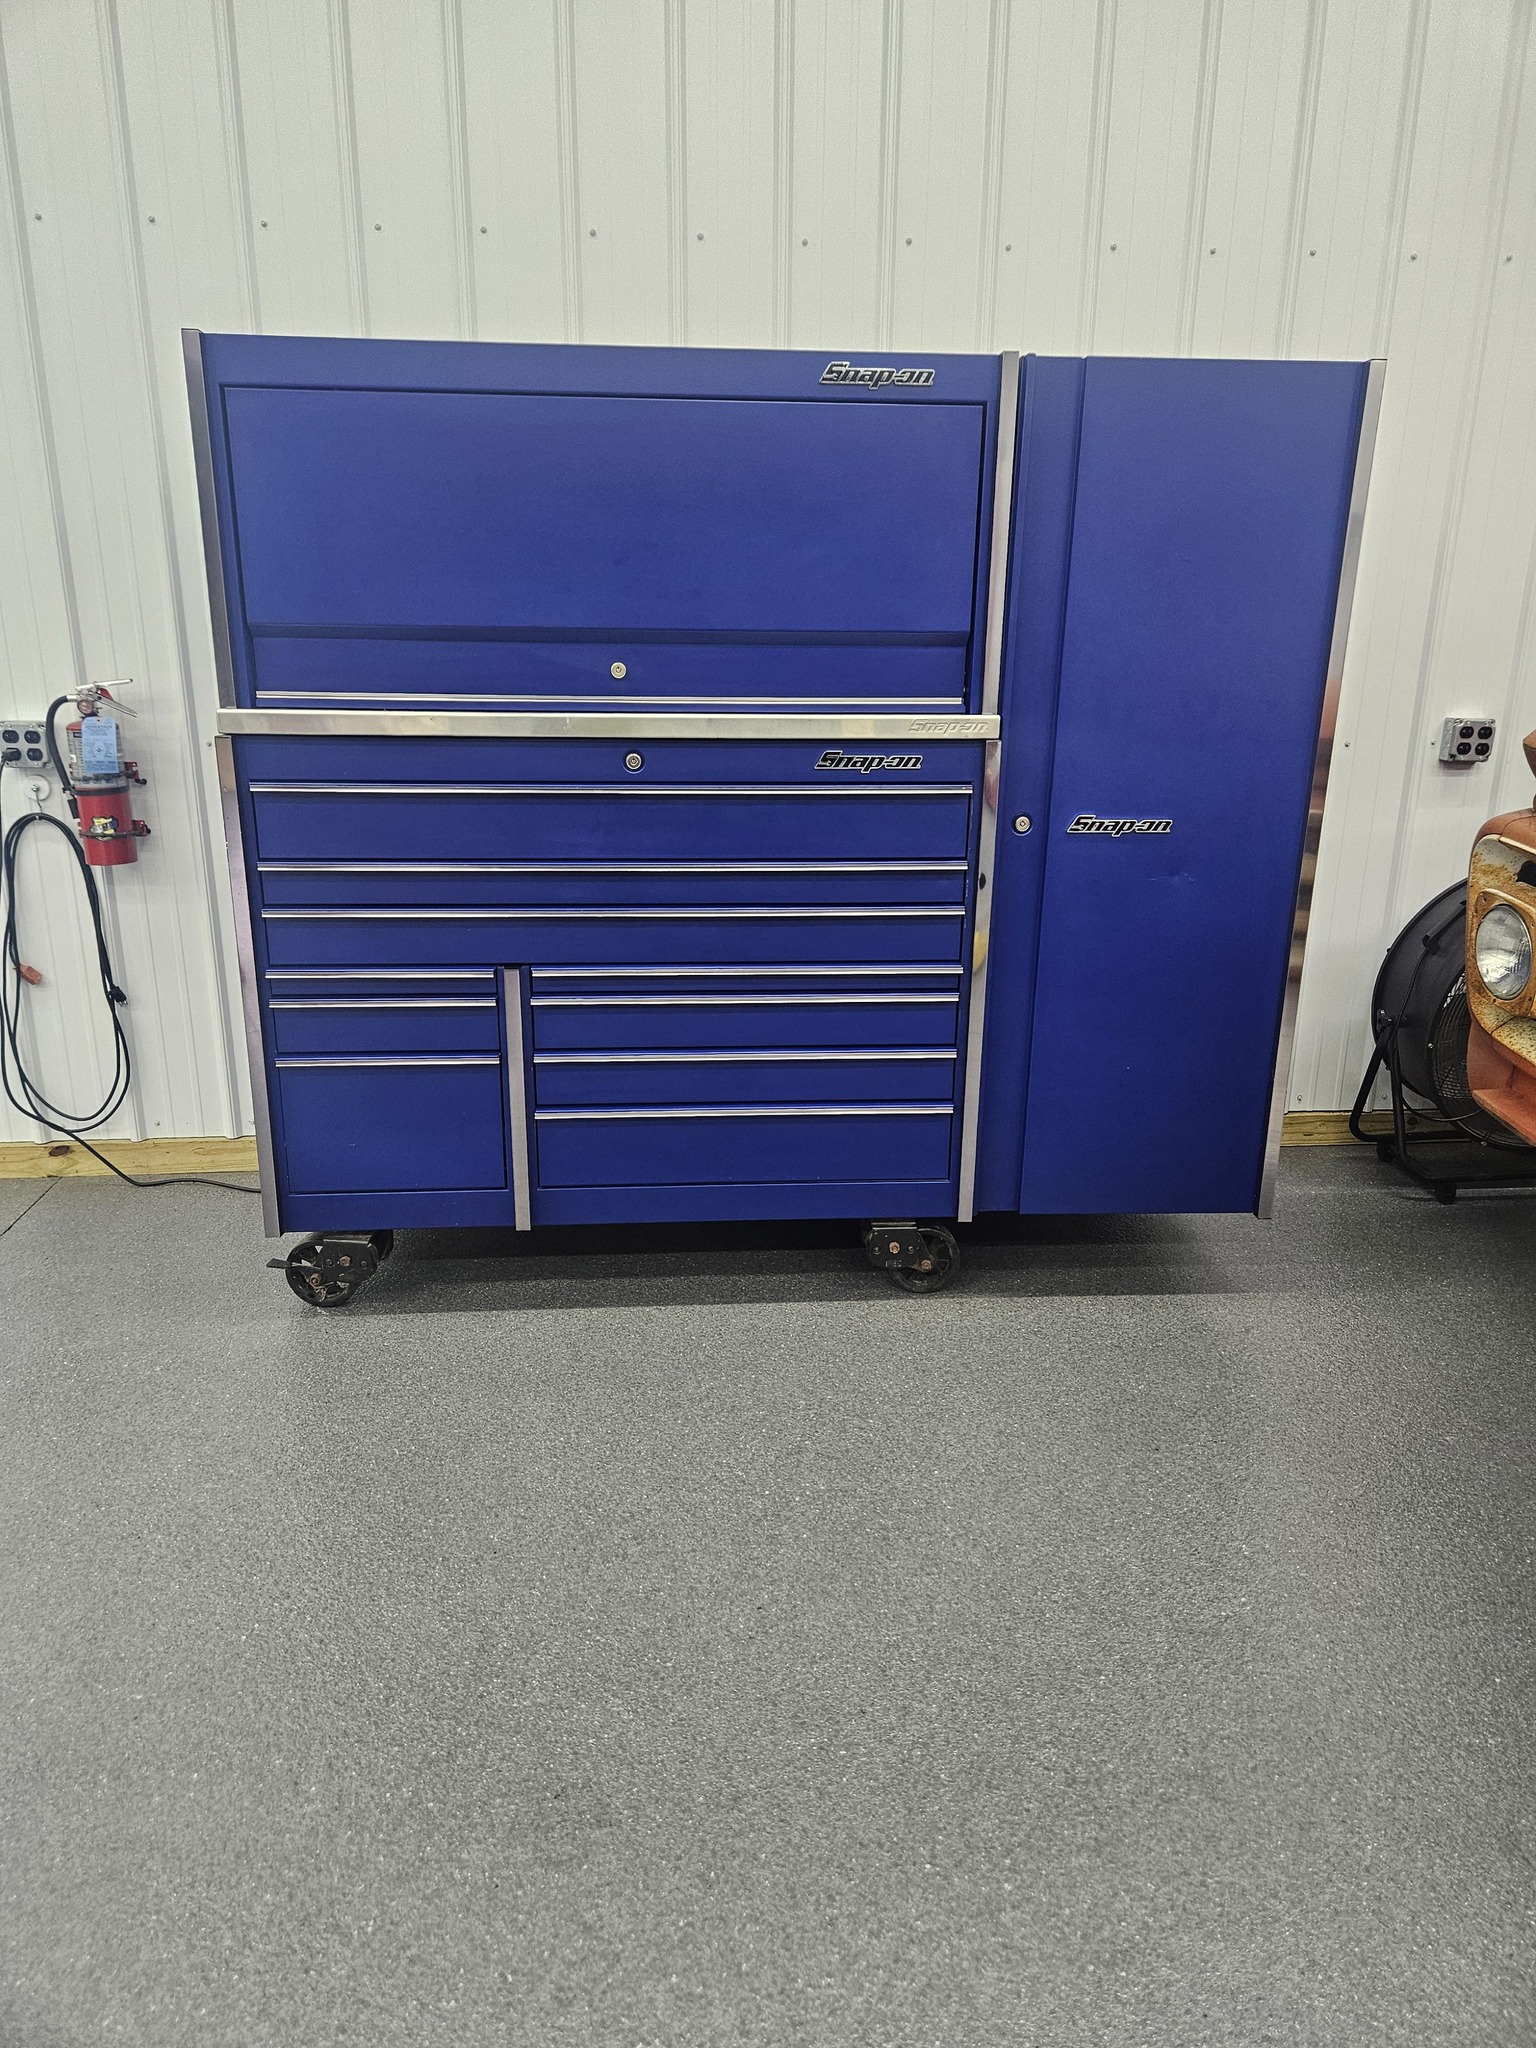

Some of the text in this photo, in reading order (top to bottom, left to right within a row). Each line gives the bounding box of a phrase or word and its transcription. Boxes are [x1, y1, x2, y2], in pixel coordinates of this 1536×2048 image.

[820, 361, 936, 390] Snap-on
[908, 719, 987, 735] Snap-on
[814, 750, 923, 773] Snap-on
[1067, 815, 1173, 837] Snap-on
